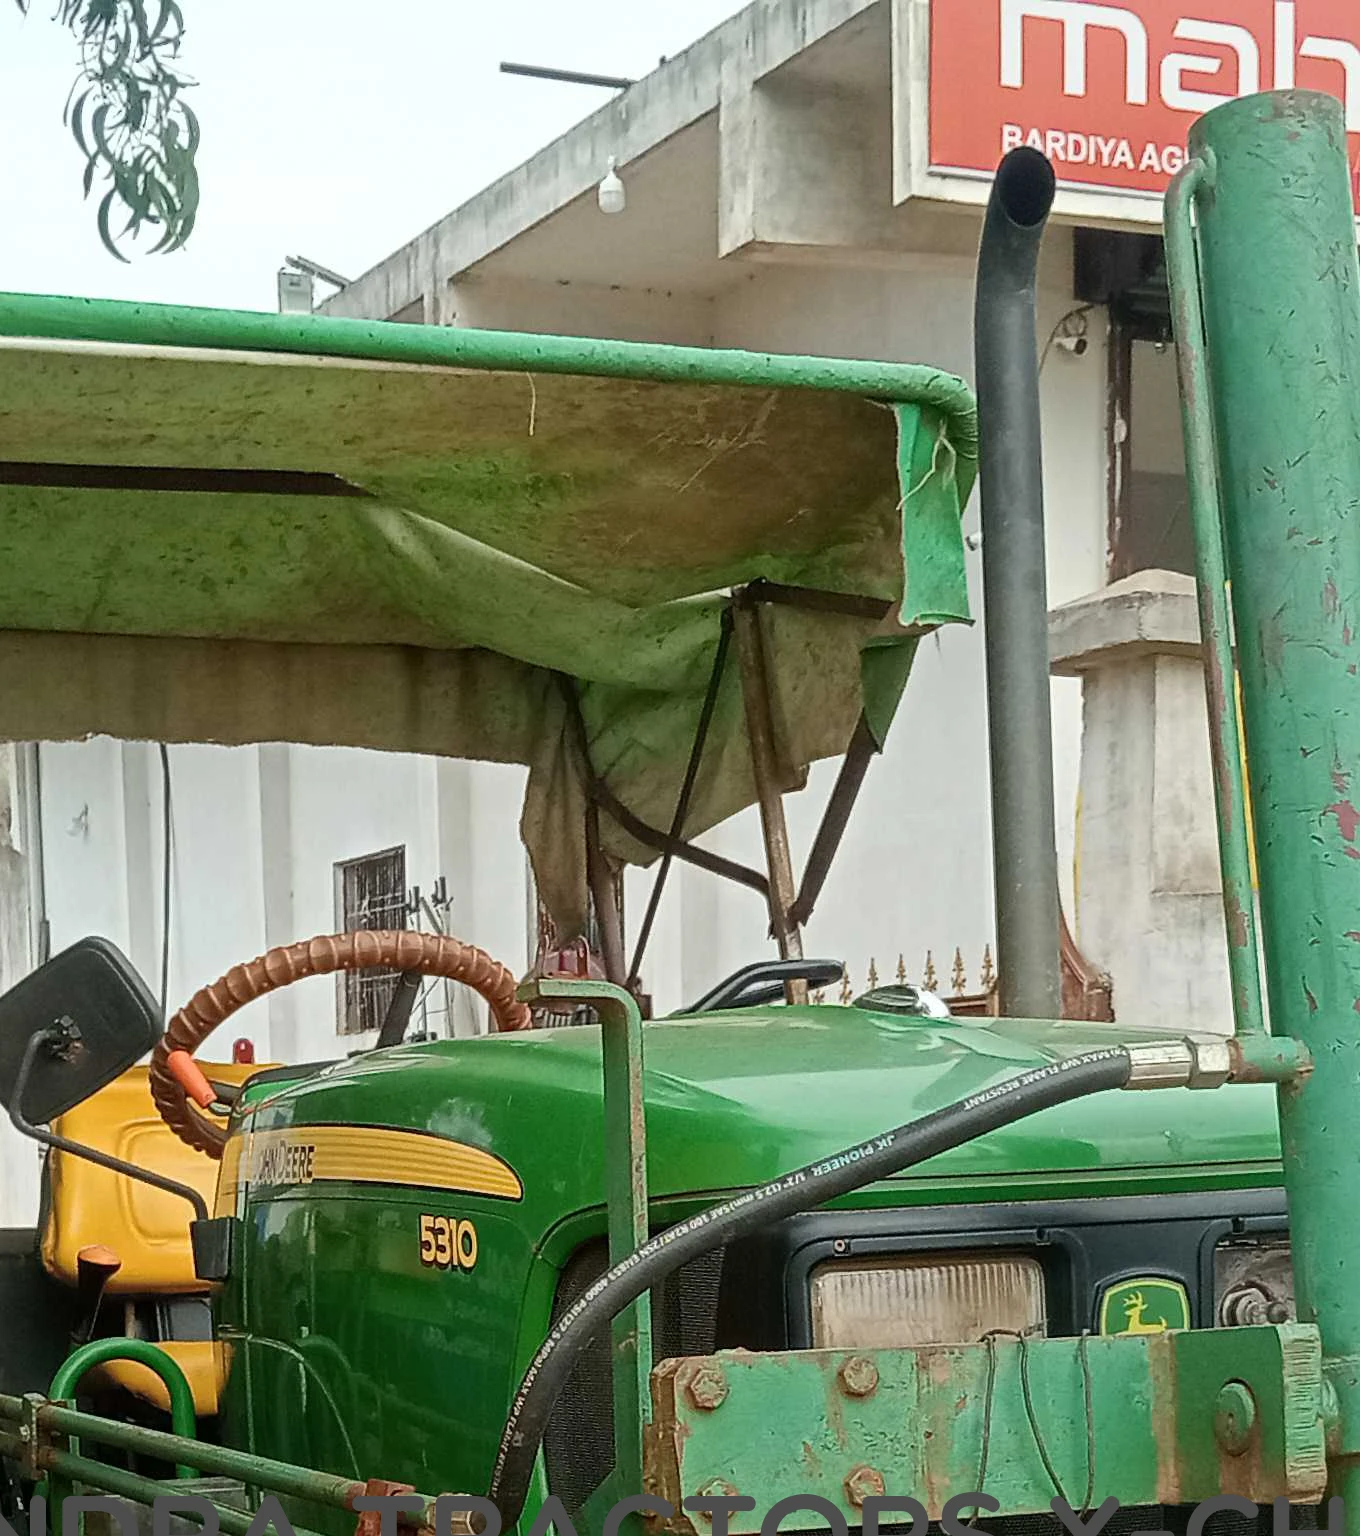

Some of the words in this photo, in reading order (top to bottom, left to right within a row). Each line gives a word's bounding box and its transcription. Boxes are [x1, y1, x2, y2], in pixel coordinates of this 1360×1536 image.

[1001, 124, 1135, 170] BARDIYA
[1139, 146, 1189, 175] AG
[1019, 1063, 1059, 1085] FLAME
[961, 1078, 1020, 1110] RESISTANT
[874, 1133, 896, 1150] JK
[277, 1139, 316, 1183] DEERE
[810, 1142, 874, 1177] PIONEER
[419, 1214, 478, 1272] 5310
